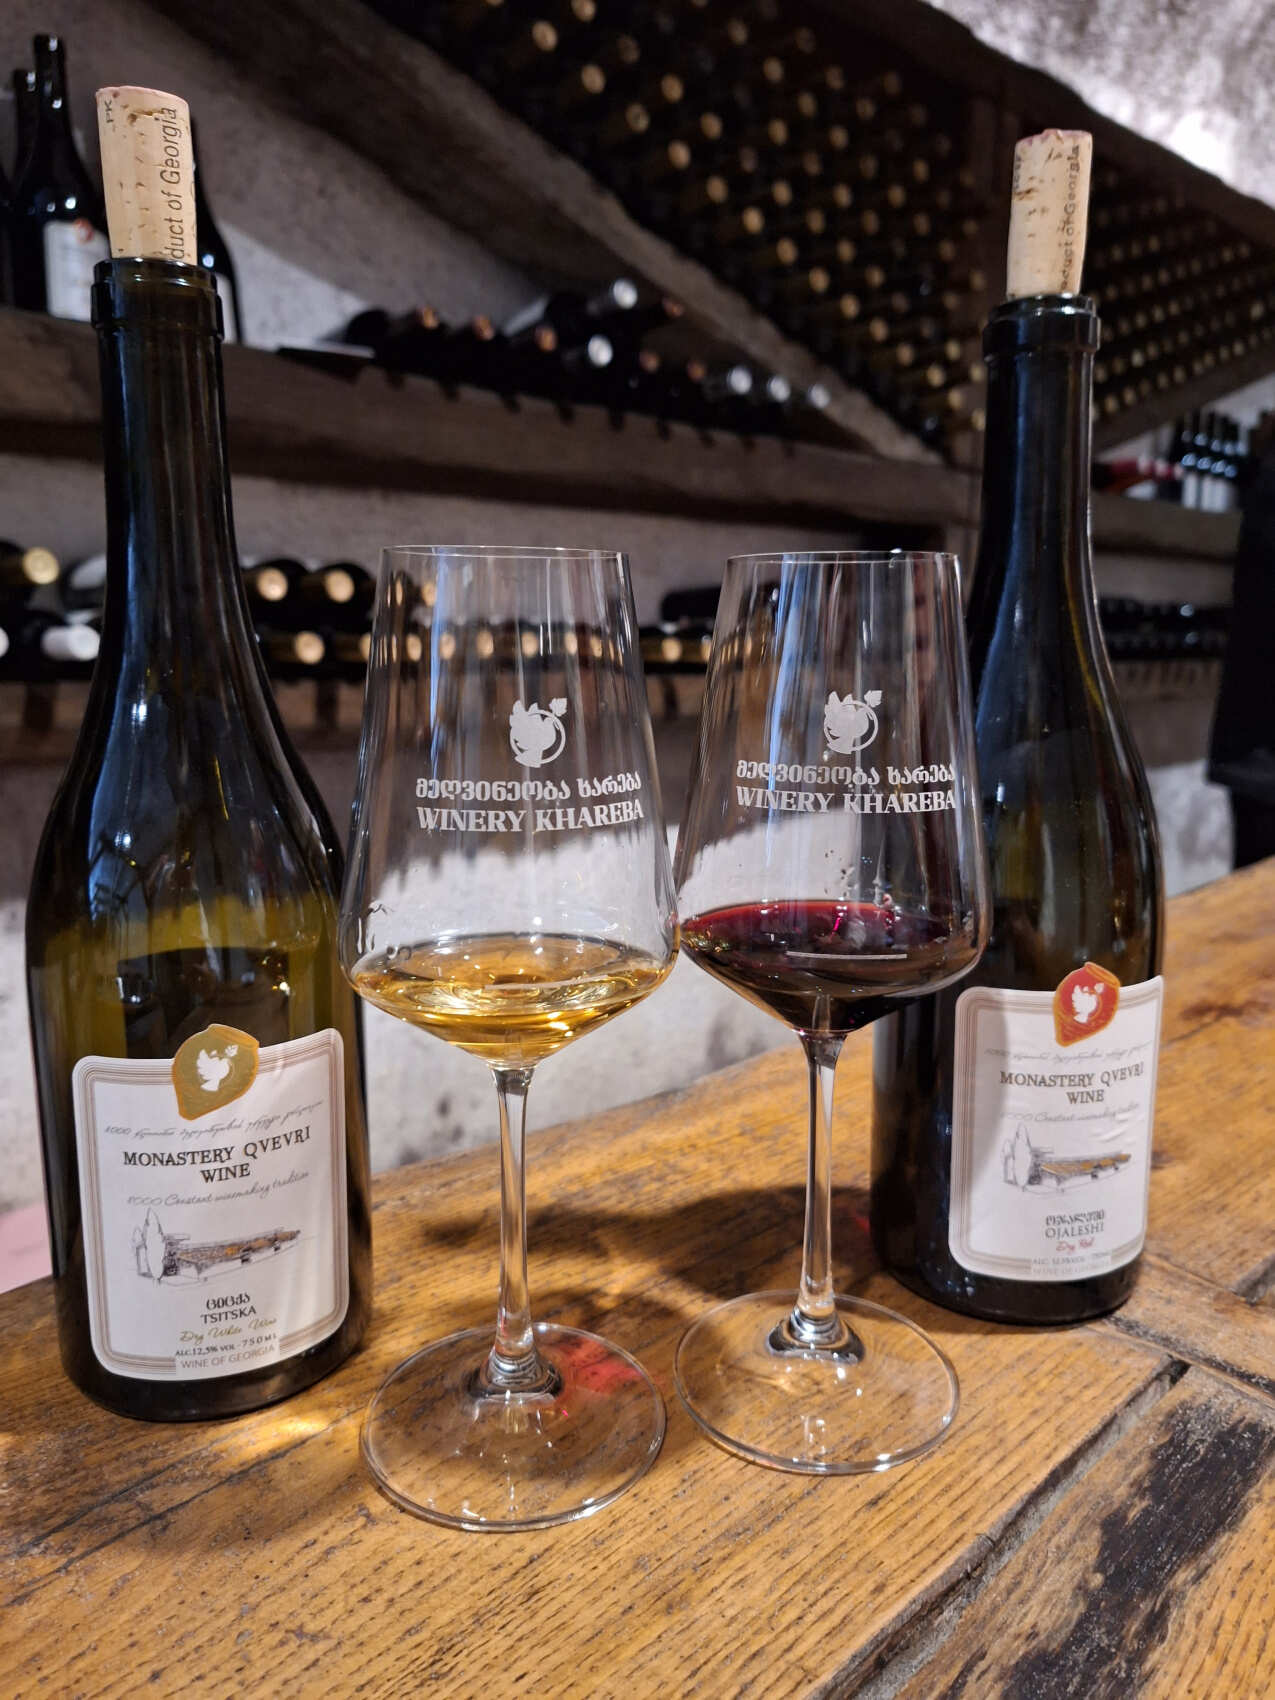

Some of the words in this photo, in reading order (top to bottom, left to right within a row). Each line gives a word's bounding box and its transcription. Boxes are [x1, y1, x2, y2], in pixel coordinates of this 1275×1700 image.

[154, 107, 183, 185] Georgia
[1064, 145, 1081, 216] Georgia
[161, 190, 183, 212] of
[415, 777, 571, 801] მეღვინეობა
[735, 785, 835, 813] WINERY
[843, 789, 957, 814] KHAREBA
[415, 806, 527, 832] WINERY
[534, 799, 645, 832] KHAREBA
[1000, 1070, 1095, 1089] MONASTERY
[1100, 1061, 1145, 1087] QVEVRI
[1066, 1089, 1105, 1105] WINE
[123, 1145, 235, 1167] MONASTERY
[243, 1125, 311, 1160] QVEVRI
[199, 1162, 251, 1184] WINE
[1044, 1221, 1105, 1241] OJALESHI
[200, 1305, 257, 1325] TSITSKA
[179, 1330, 205, 1346] Dry
[180, 1357, 209, 1369] WINE
[210, 1355, 225, 1366] OF
